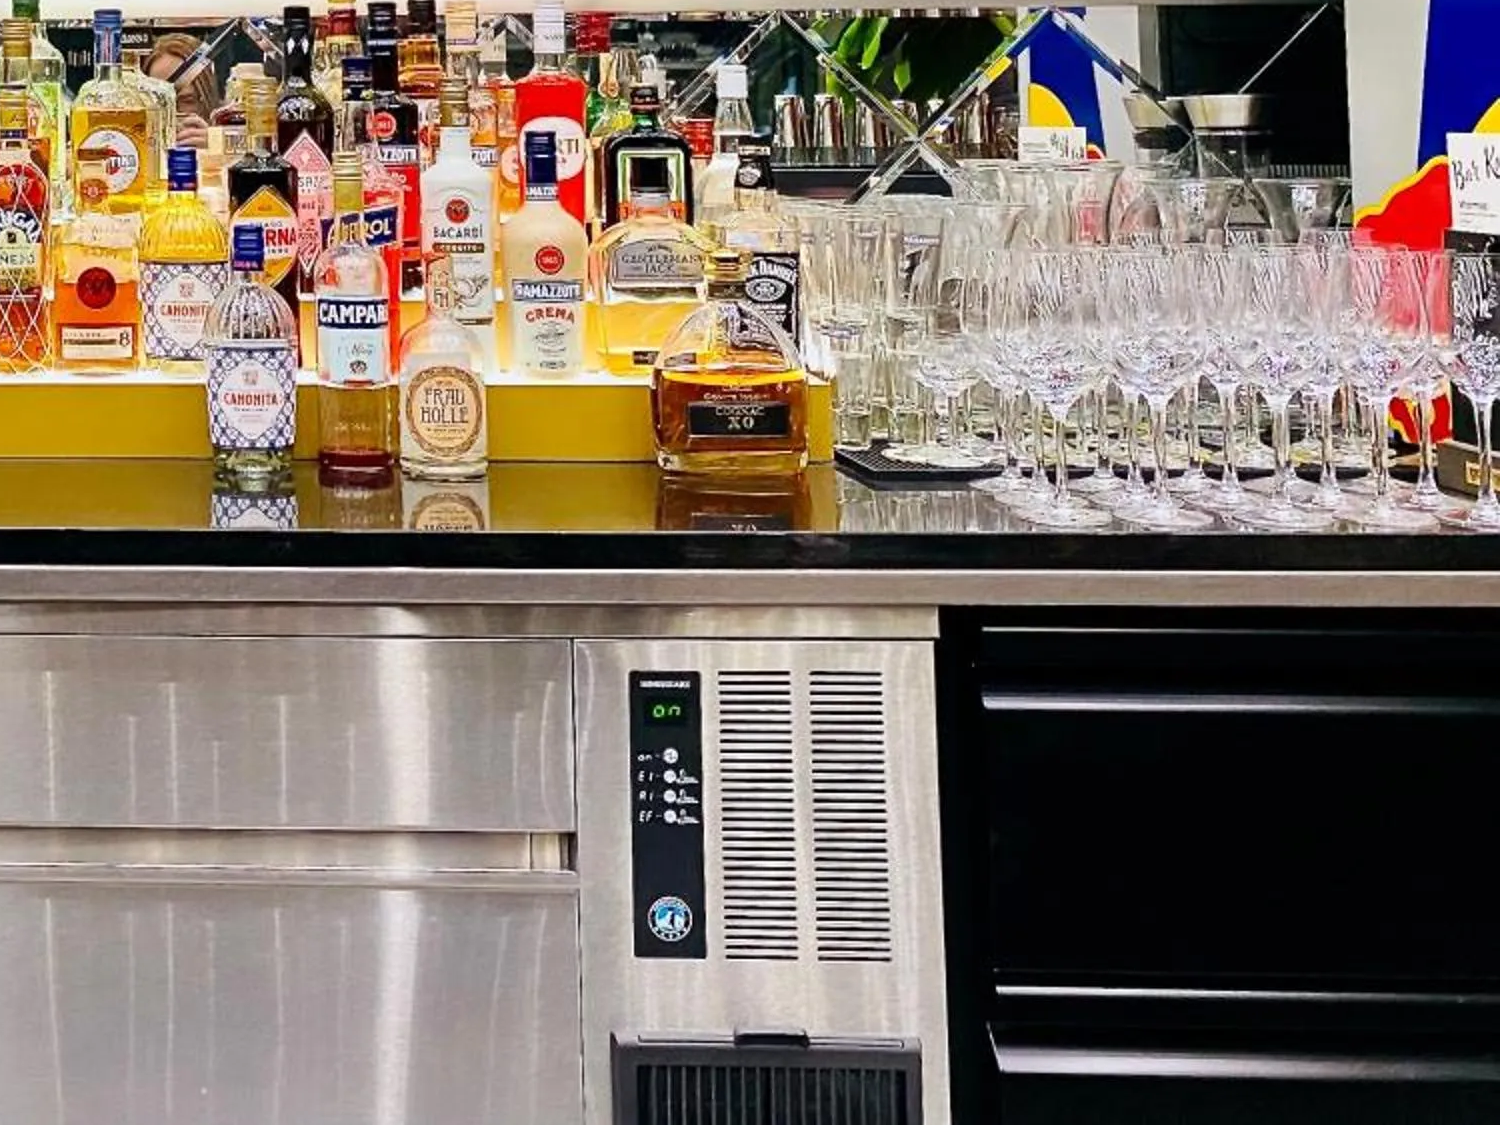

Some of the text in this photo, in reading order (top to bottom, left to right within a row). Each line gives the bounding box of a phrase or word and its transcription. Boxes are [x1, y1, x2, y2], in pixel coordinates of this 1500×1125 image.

[525, 306, 575, 324] CREMA
[424, 388, 465, 405] FRAU
[420, 406, 469, 424] HOLLE
[715, 405, 766, 416] COGNAC
